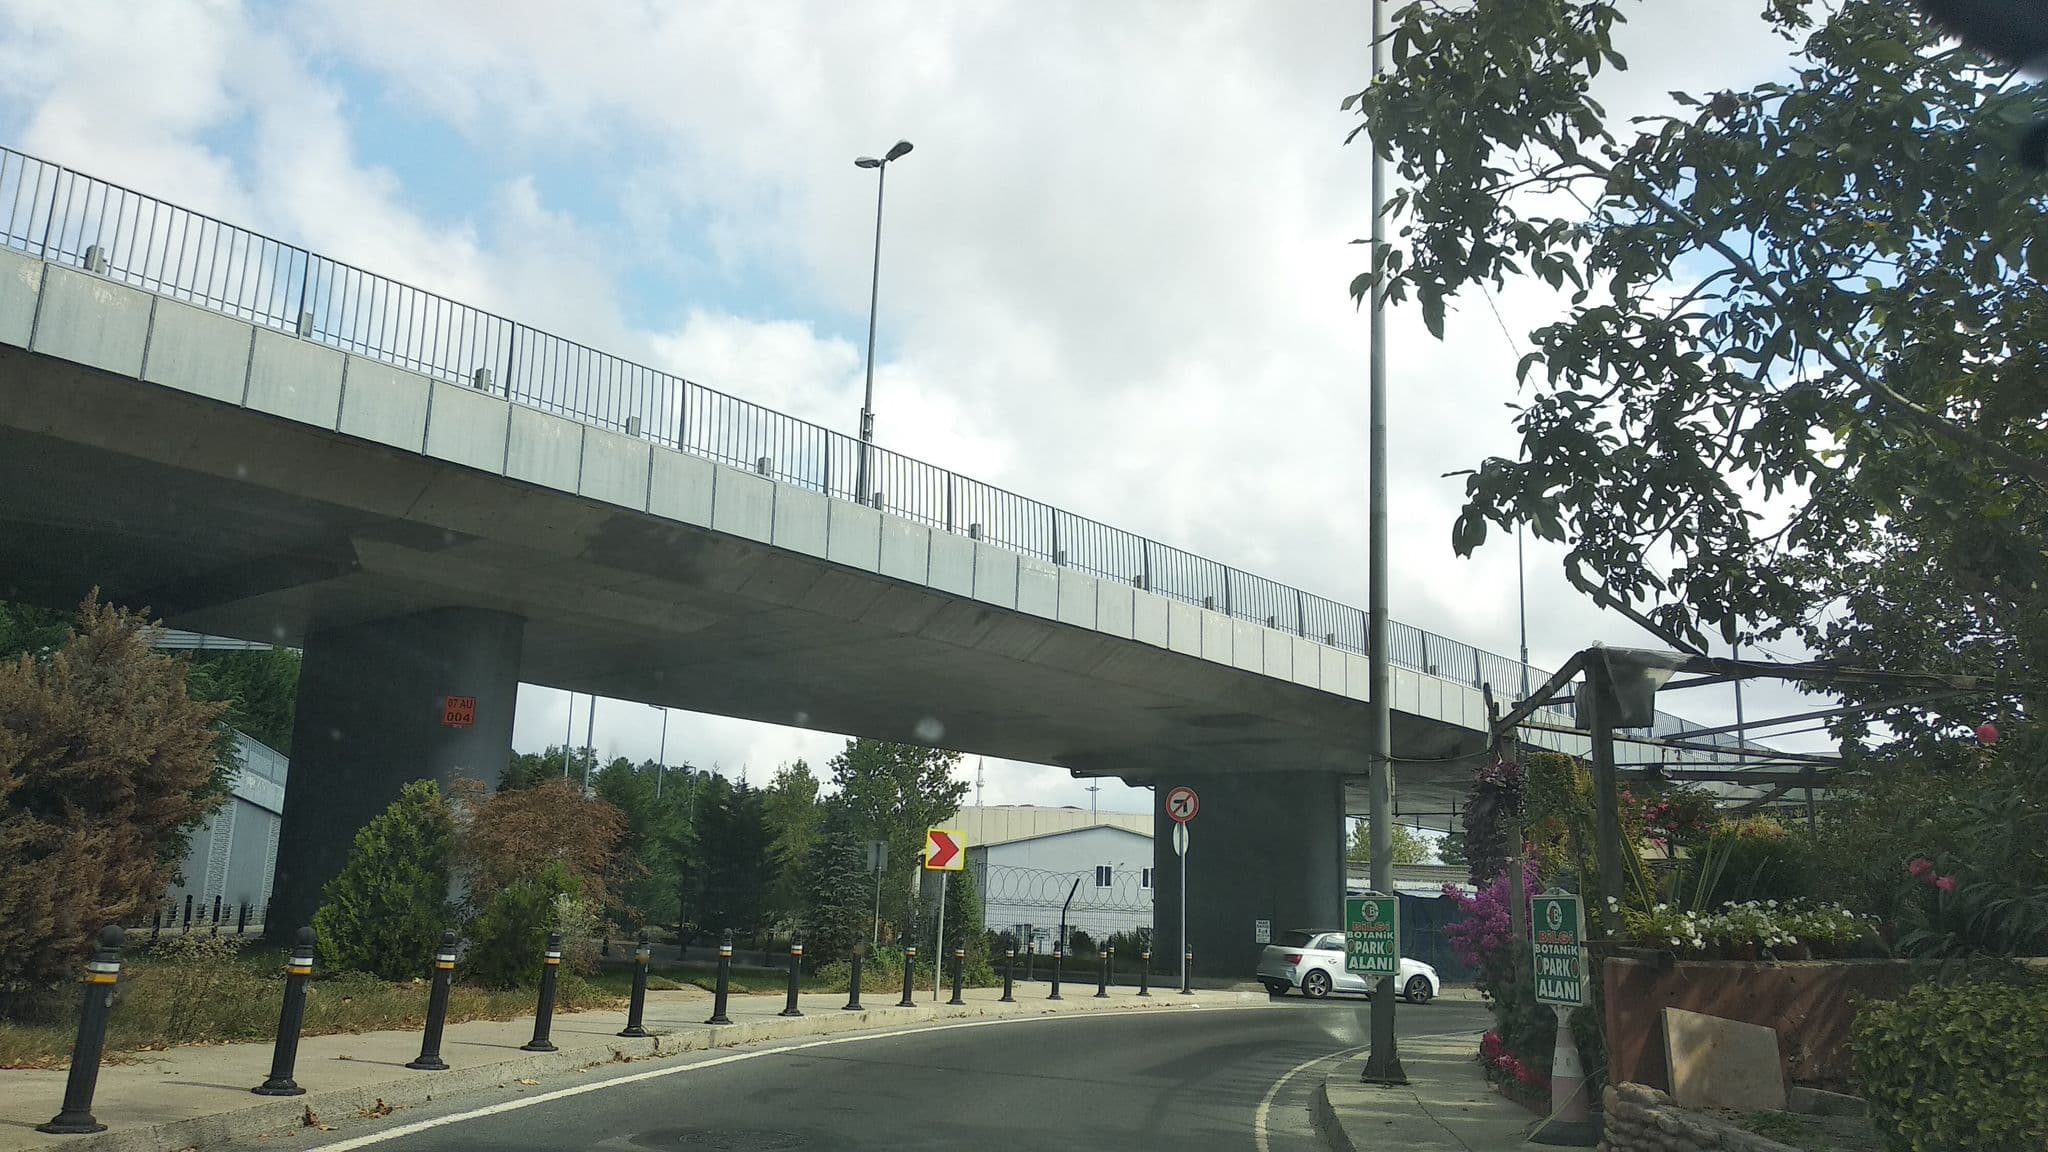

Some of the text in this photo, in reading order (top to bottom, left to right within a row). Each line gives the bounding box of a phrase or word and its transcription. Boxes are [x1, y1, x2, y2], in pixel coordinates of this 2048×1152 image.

[459, 698, 473, 709] AU
[447, 711, 470, 722] 004
[1355, 941, 1385, 955] PARK
[1348, 956, 1393, 971] ALANI
[1543, 957, 1571, 977] PARK
[1538, 979, 1580, 1001] ALANI
